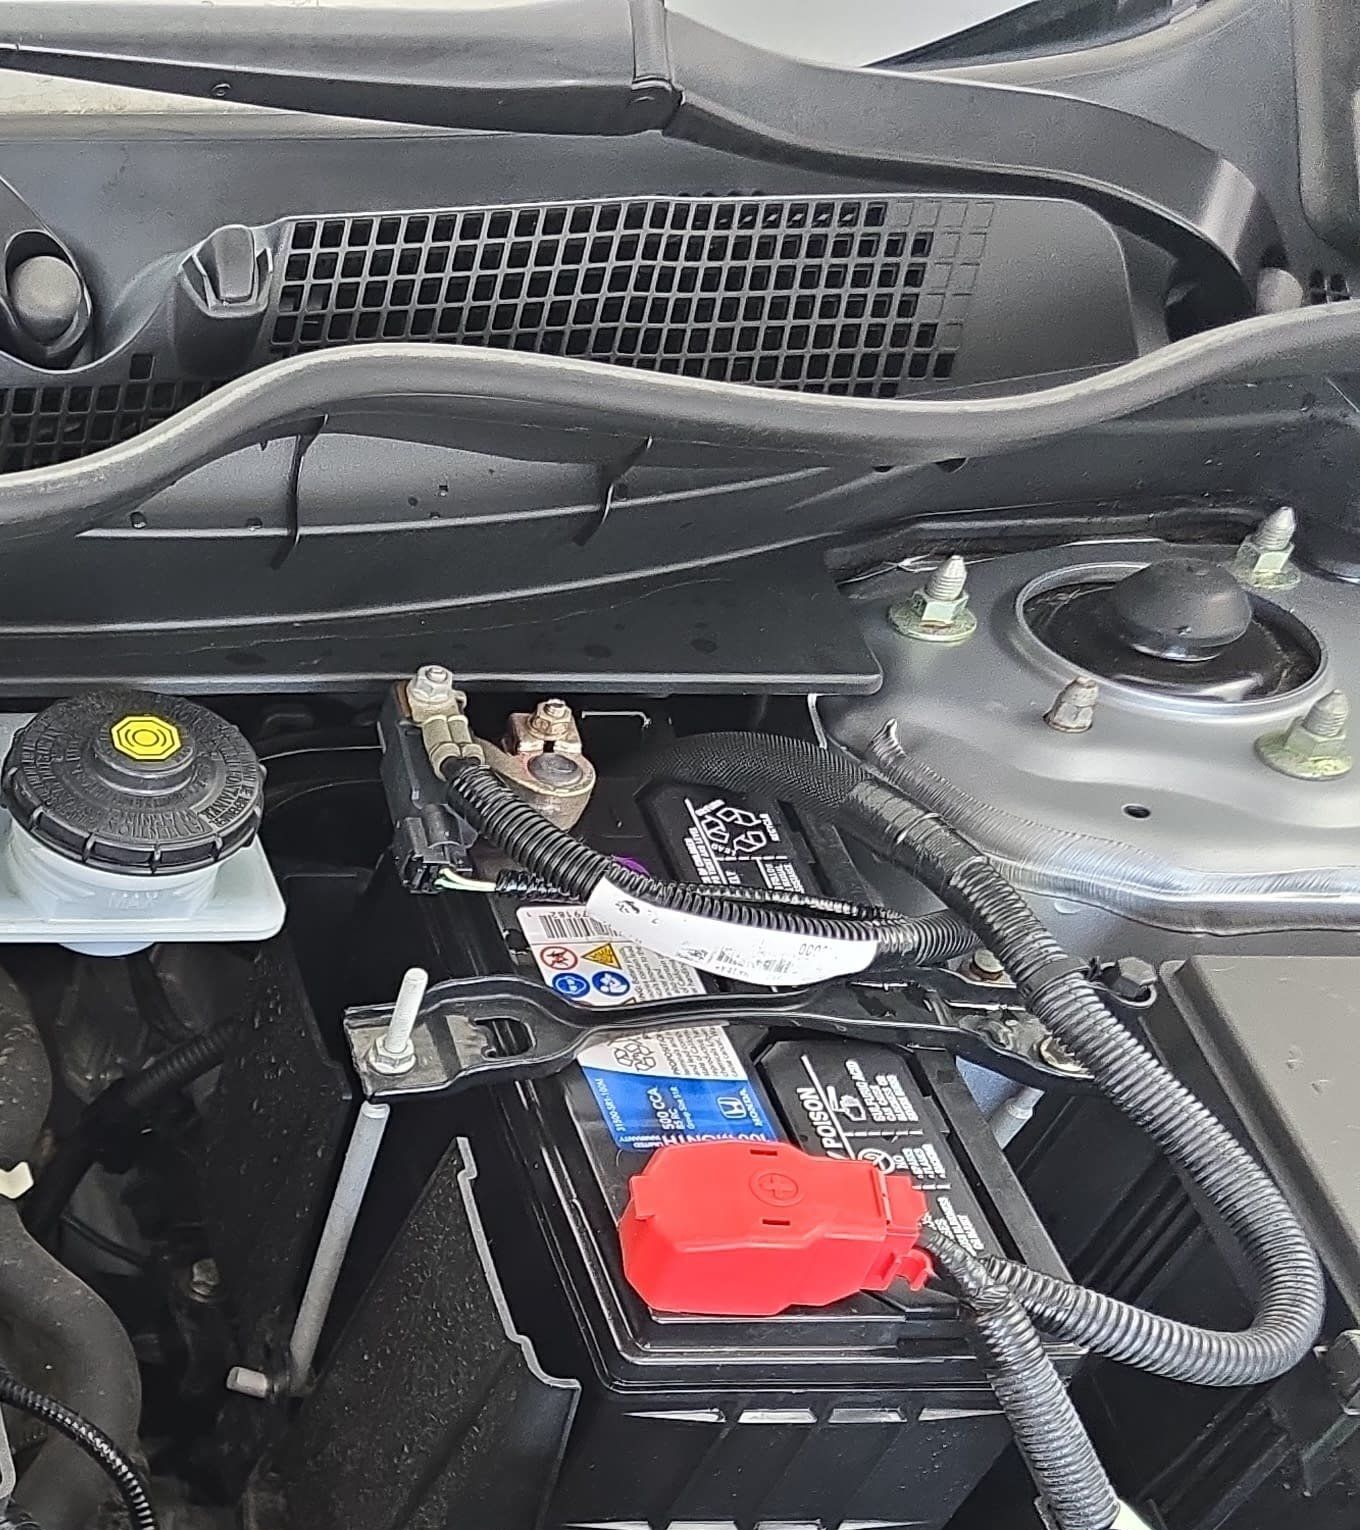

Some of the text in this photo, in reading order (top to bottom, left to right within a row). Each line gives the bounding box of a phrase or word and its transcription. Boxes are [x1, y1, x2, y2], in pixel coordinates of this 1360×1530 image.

[646, 1086, 675, 1130] 500 CCA
[739, 1088, 763, 1127] HONDA
